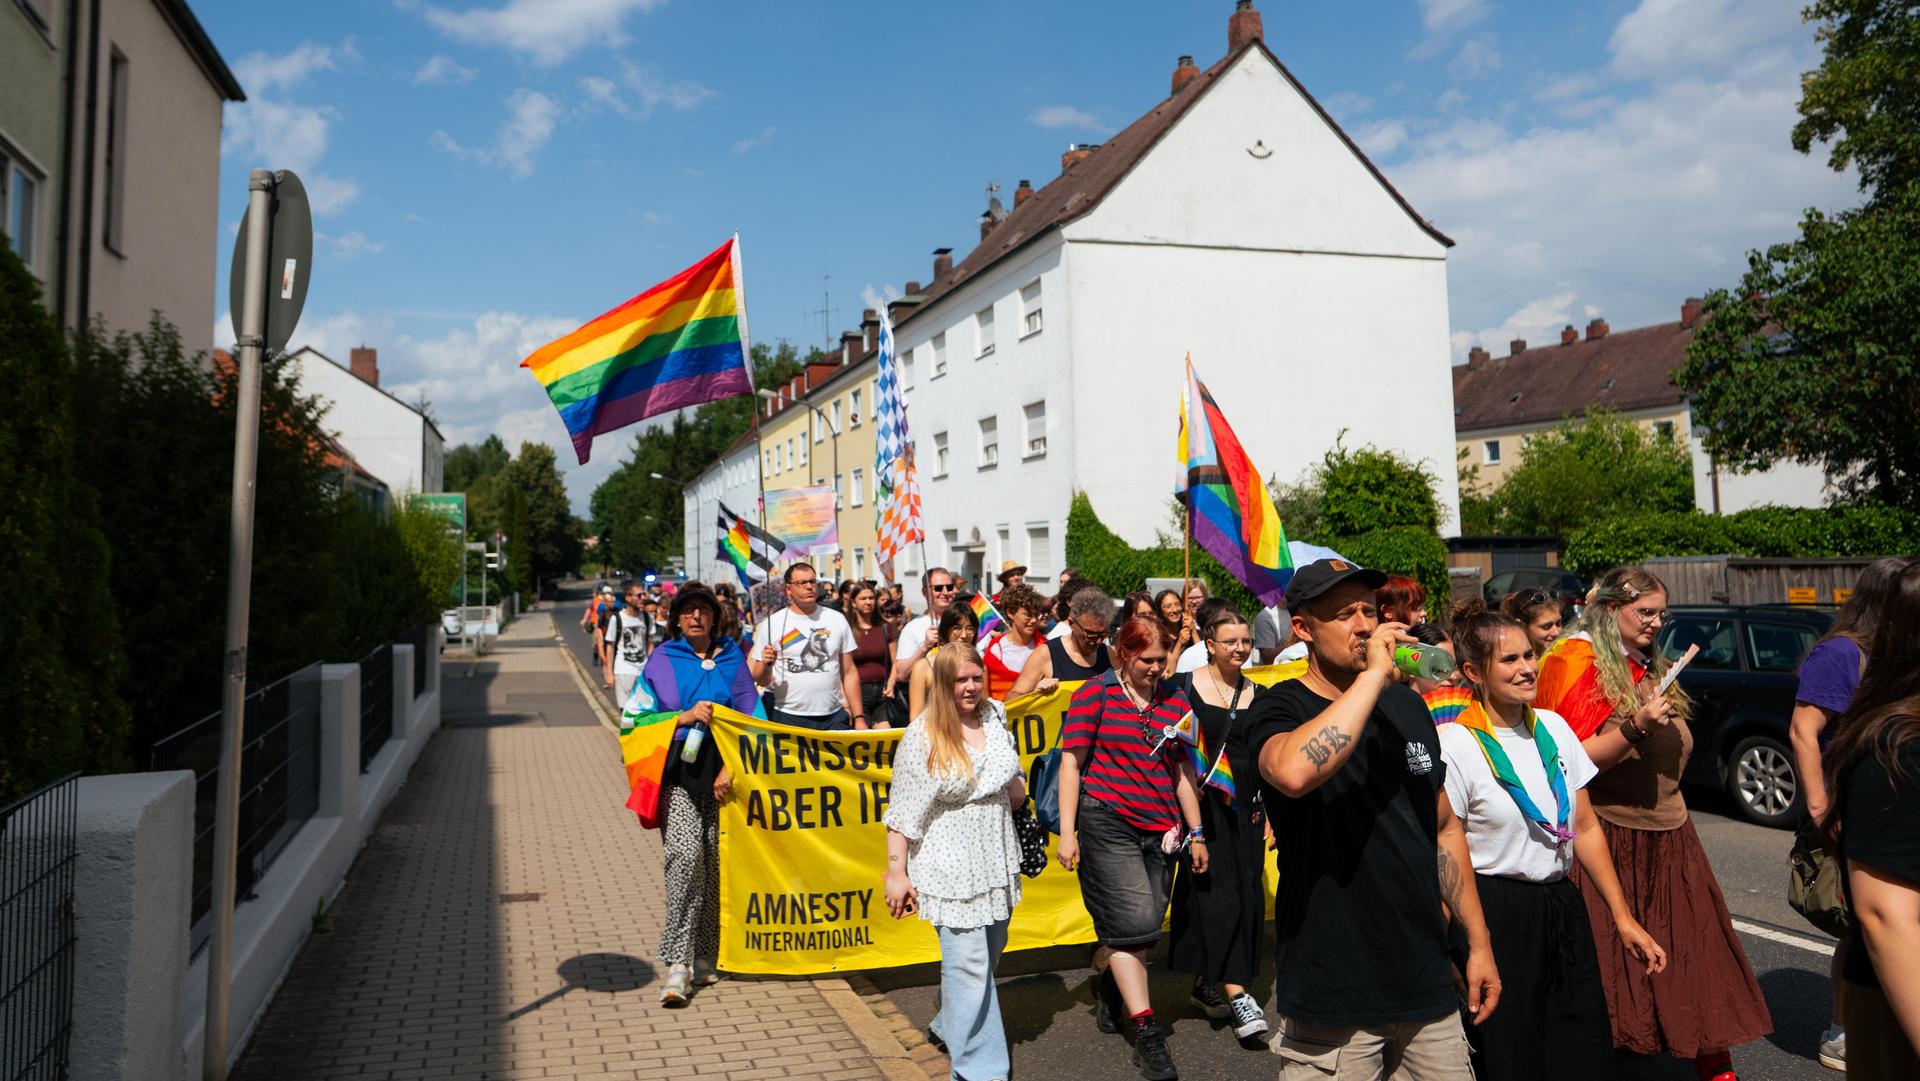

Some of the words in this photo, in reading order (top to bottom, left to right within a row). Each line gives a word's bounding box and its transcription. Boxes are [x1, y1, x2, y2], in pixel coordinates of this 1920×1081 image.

[738, 733, 899, 775] MENSCH
[747, 785, 844, 831] ABER
[858, 782, 891, 824] IH
[745, 888, 874, 925] AMNESTY
[745, 926, 874, 952] INTERNATIONAL
